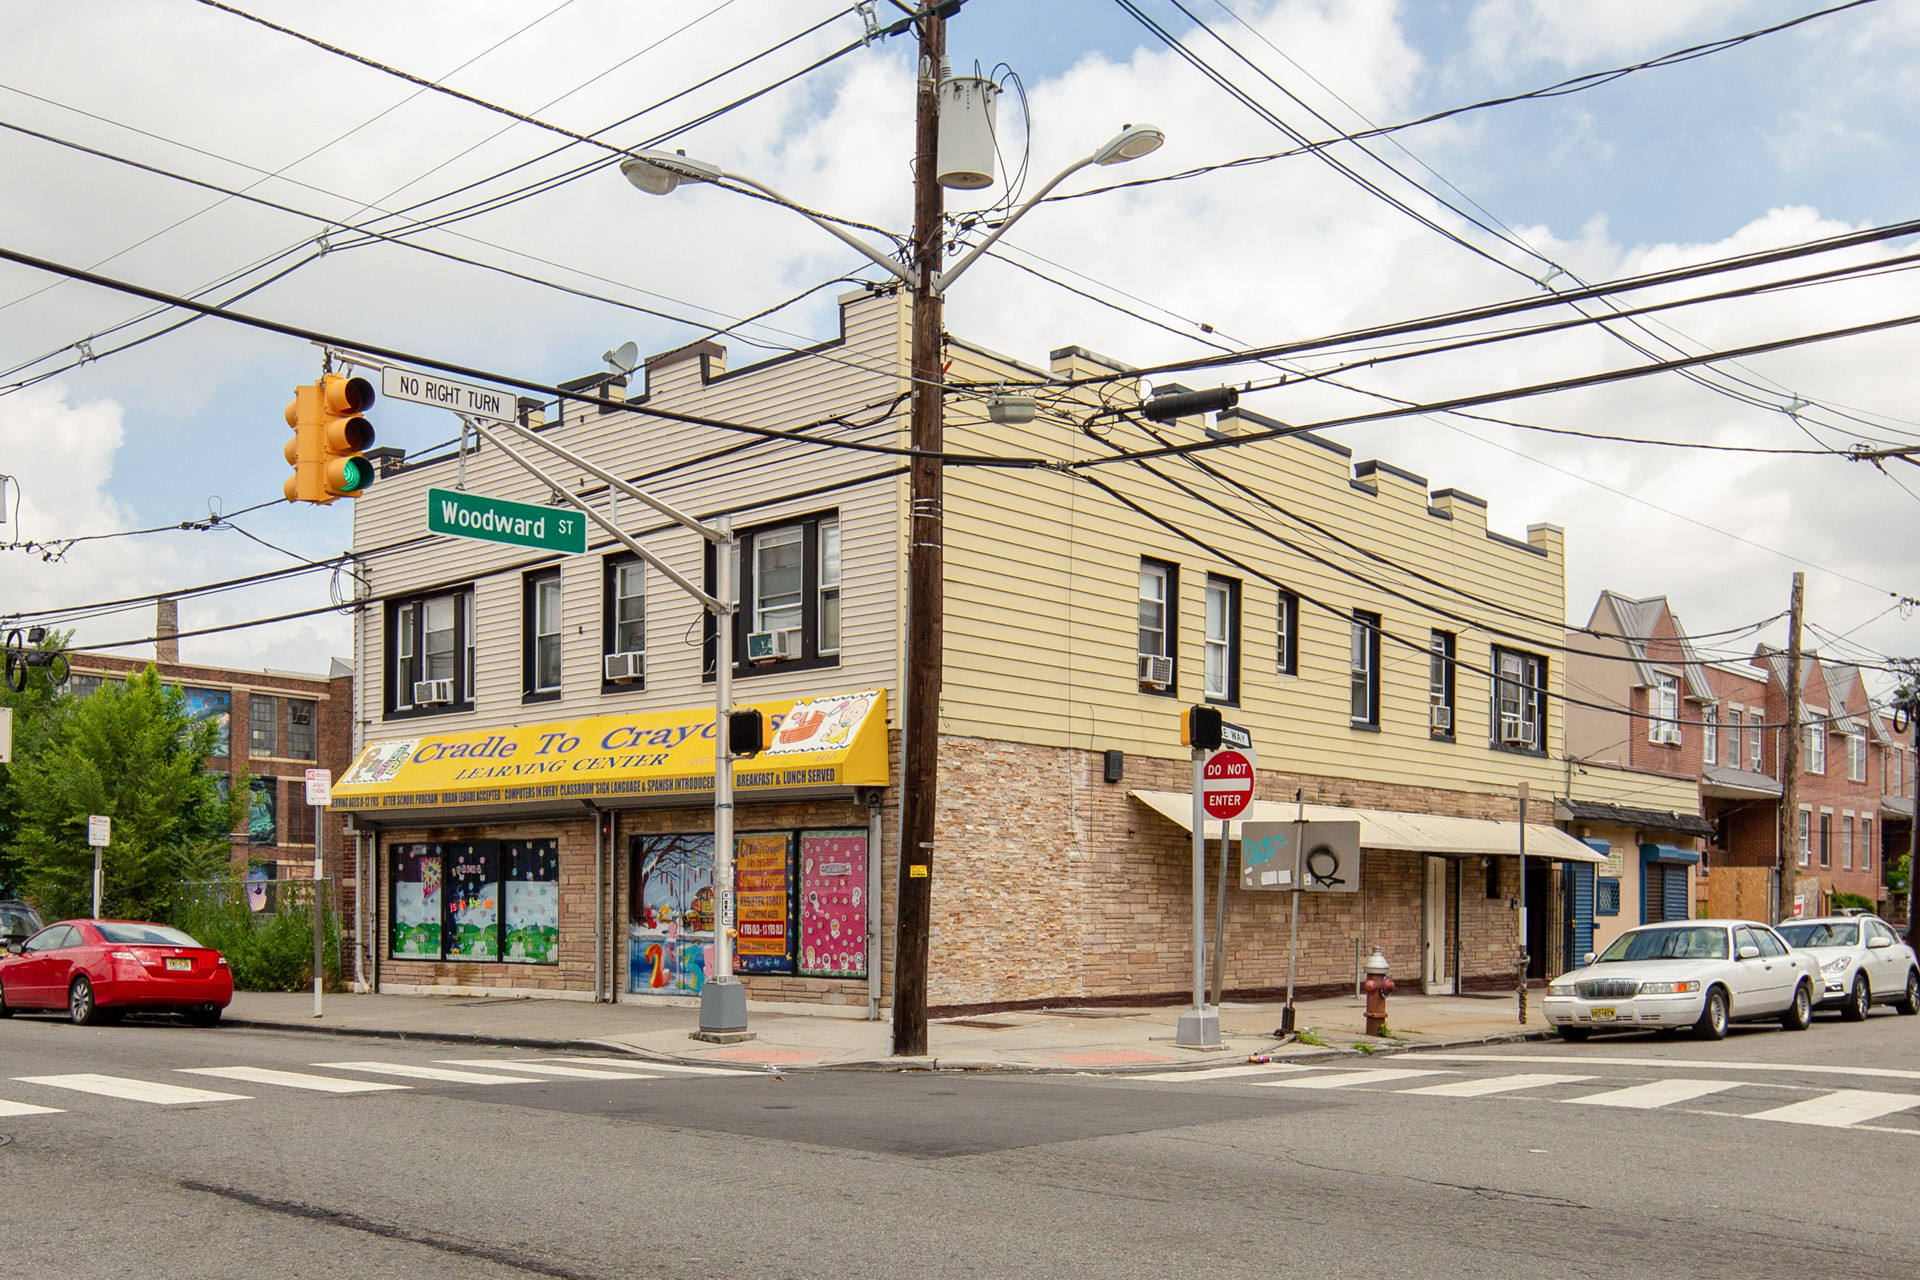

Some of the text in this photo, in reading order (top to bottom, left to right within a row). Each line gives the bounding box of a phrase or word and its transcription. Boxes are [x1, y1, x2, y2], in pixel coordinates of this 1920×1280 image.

[400, 376, 500, 414] NO RIGHT TURN
[442, 500, 574, 539] Woodward ST
[1231, 730, 1246, 743] WAY
[412, 736, 518, 764] Cradle
[533, 732, 581, 756] To
[454, 753, 669, 780] LEARNING CENTER
[1208, 763, 1247, 775] DO NOT
[371, 796, 379, 806] YRS
[383, 795, 396, 806] AFTER
[397, 794, 415, 805] SCHOOL
[415, 793, 438, 804] PROGRAM
[442, 792, 457, 803] URBAN
[459, 790, 475, 802] LEAGUE
[476, 789, 500, 801] ACCEPTED
[504, 786, 535, 800] COMPUTERS
[536, 786, 541, 798] IN
[543, 785, 558, 797] EVERY
[560, 782, 594, 796] CLASSROOM
[596, 781, 609, 794] SIGN
[611, 779, 640, 793] LANGUAGE
[642, 781, 646, 792] &
[647, 778, 673, 791] SPANISH
[675, 776, 714, 790] INTRODUCED
[736, 772, 774, 787] BREAKFAST
[776, 774, 781, 785] &
[783, 770, 806, 784] LUNCH
[808, 768, 835, 782] SERVED
[1209, 794, 1241, 806] ENTER
[450, 897, 494, 912] is in the air
[740, 895, 765, 907] REGISTER
